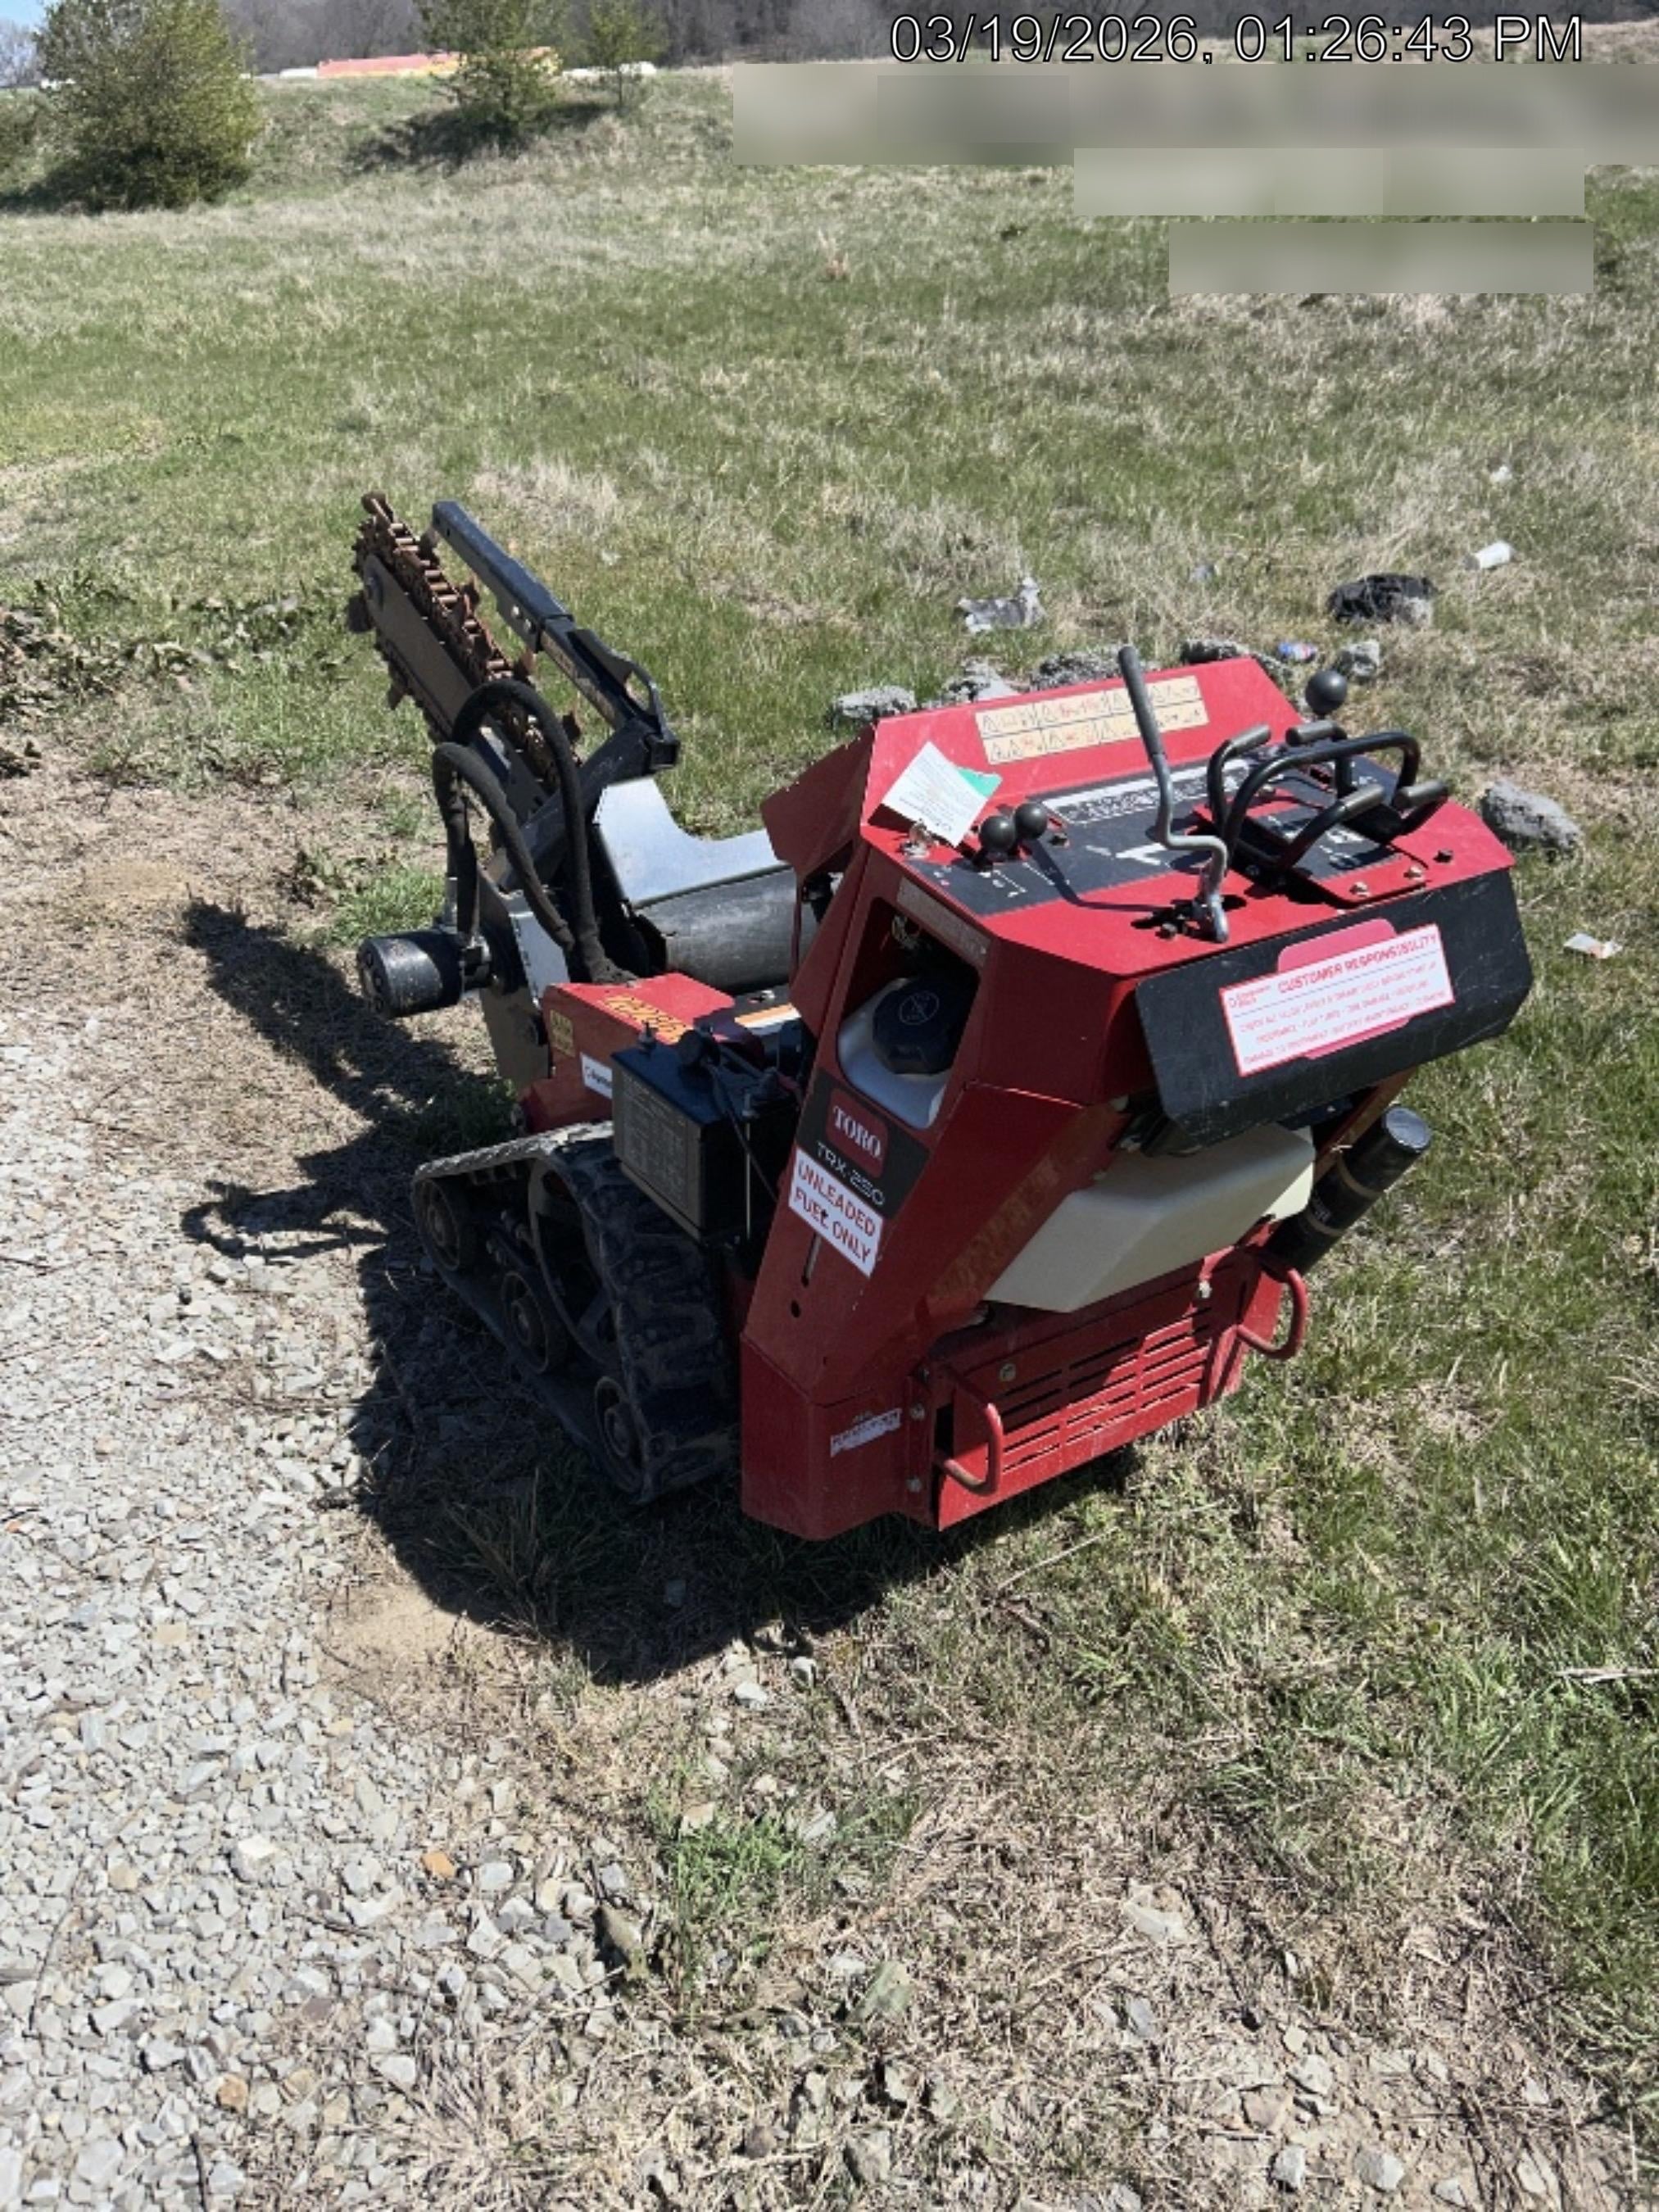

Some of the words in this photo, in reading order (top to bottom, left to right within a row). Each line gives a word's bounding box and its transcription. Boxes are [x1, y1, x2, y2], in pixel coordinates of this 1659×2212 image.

[1277, 963, 1344, 994] CUSTOMER
[1344, 932, 1438, 970] RESPONSIBILITY
[833, 1105, 882, 1158] TORO
[795, 1185, 828, 1230] FUEL
[832, 1220, 871, 1263] ONLY
[798, 1160, 875, 1237] UNLEADED
